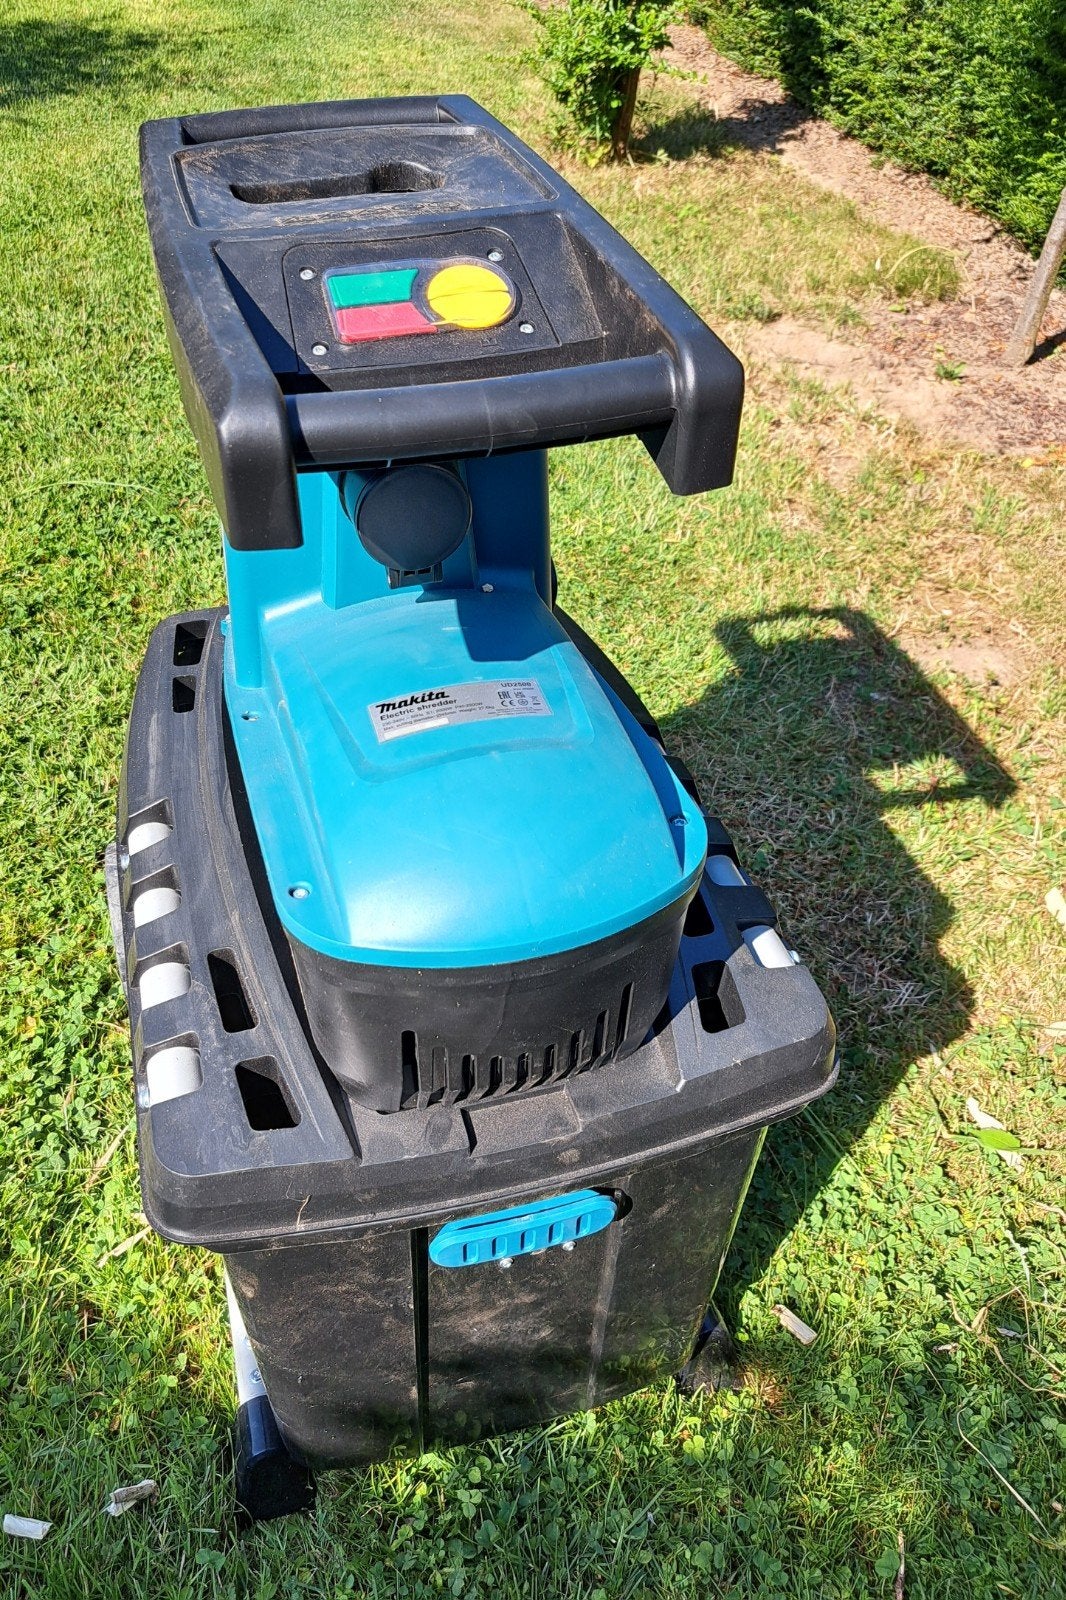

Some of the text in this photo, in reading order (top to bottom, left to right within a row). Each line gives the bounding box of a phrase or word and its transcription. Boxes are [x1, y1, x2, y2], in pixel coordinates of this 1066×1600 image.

[376, 691, 450, 714] makita
[380, 708, 414, 720] Electric
[417, 700, 457, 711] shredder
